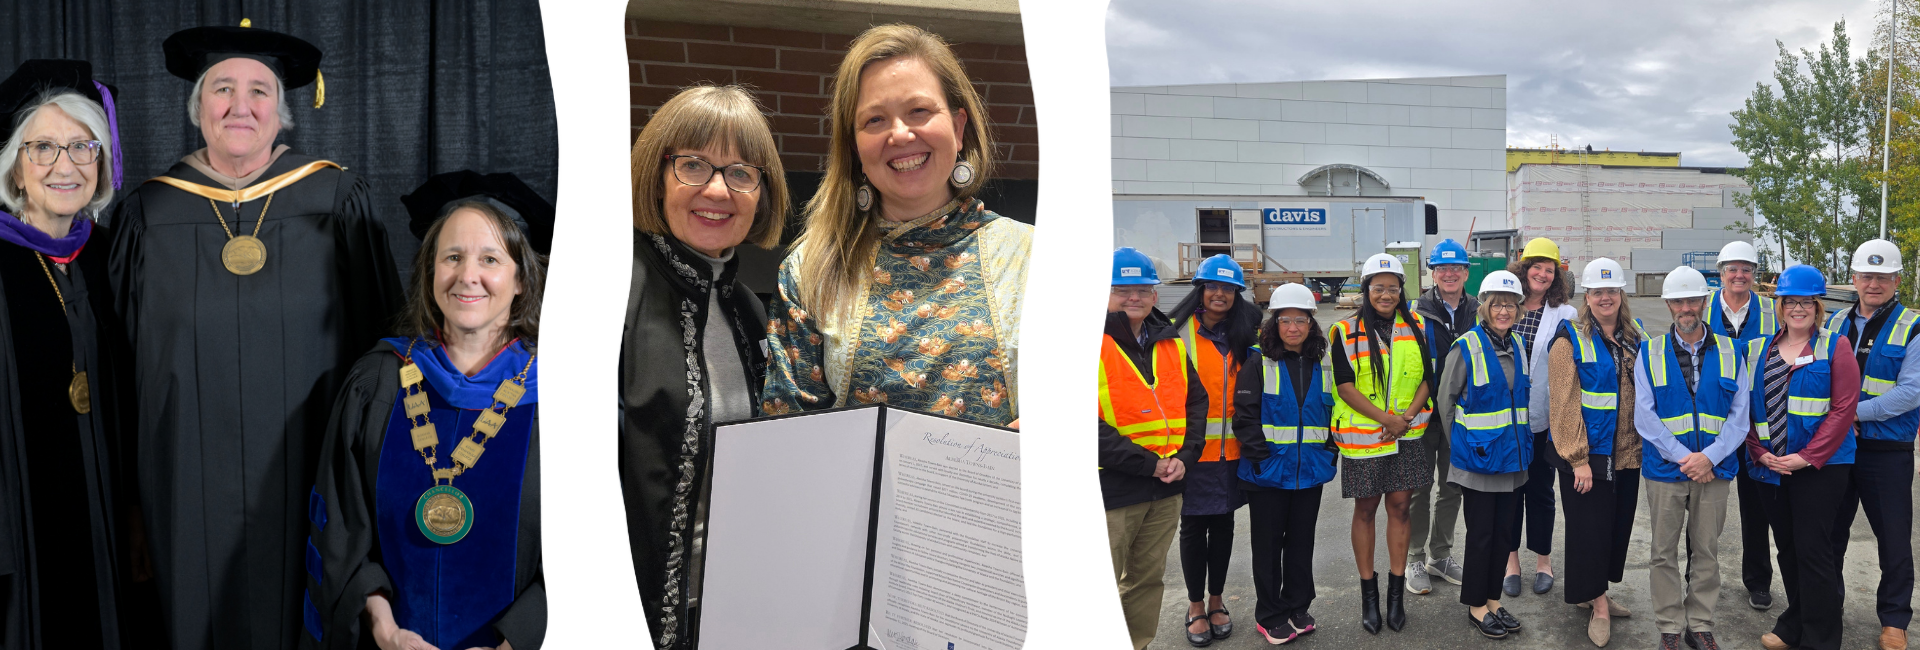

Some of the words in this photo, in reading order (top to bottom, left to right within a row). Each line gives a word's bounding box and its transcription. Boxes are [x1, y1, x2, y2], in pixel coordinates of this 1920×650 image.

[1269, 207, 1320, 222] davis
[922, 431, 962, 449] Resolution
[963, 437, 982, 460] of
[974, 443, 1020, 463] Appreciatio
